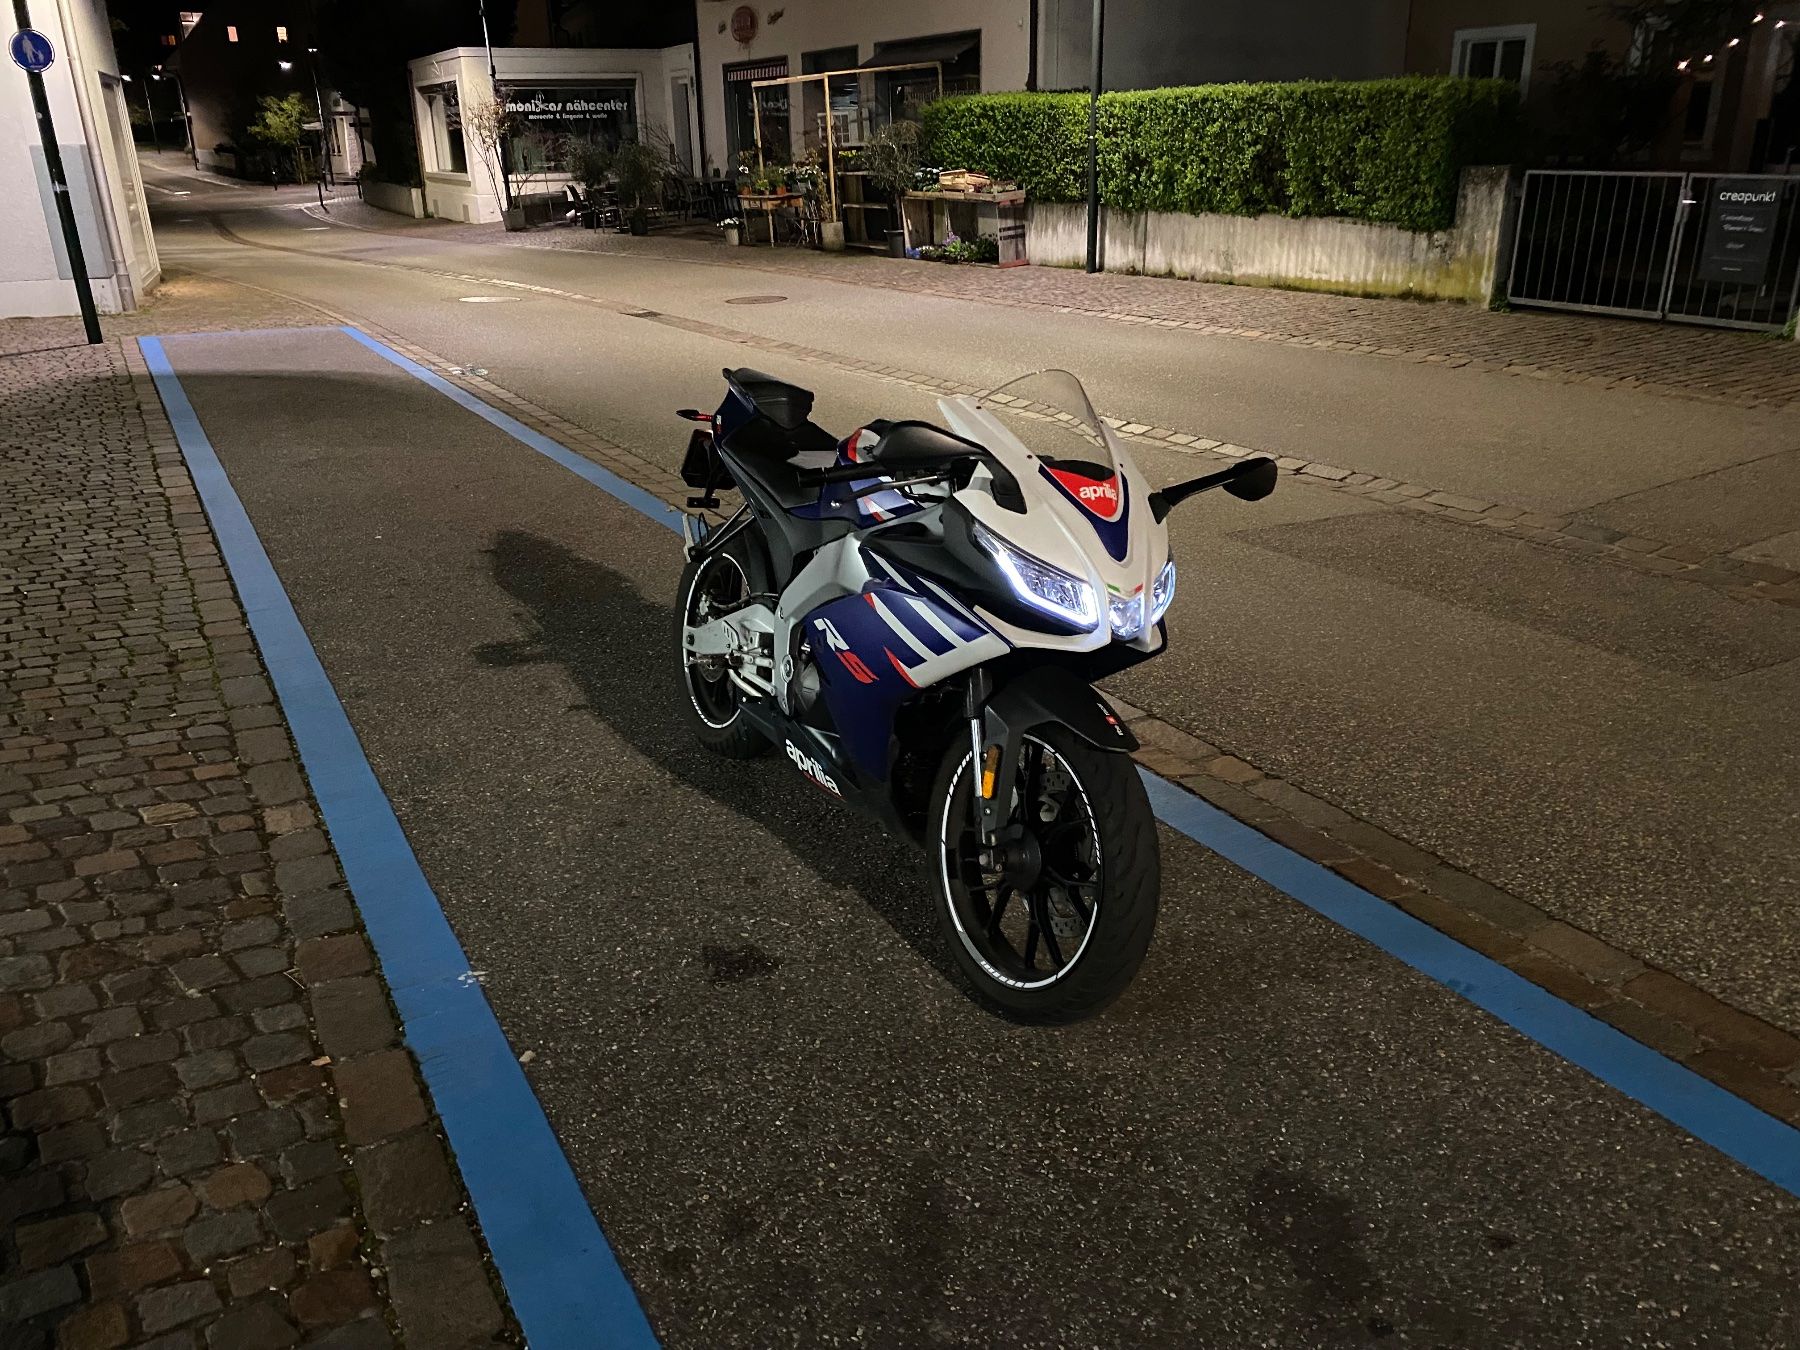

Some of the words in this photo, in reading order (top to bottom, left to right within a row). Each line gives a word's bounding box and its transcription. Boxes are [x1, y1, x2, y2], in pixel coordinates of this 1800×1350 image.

[566, 99, 628, 111] nähcenter
[1719, 191, 1777, 204] creapunkt
[785, 738, 842, 797] aprilia
